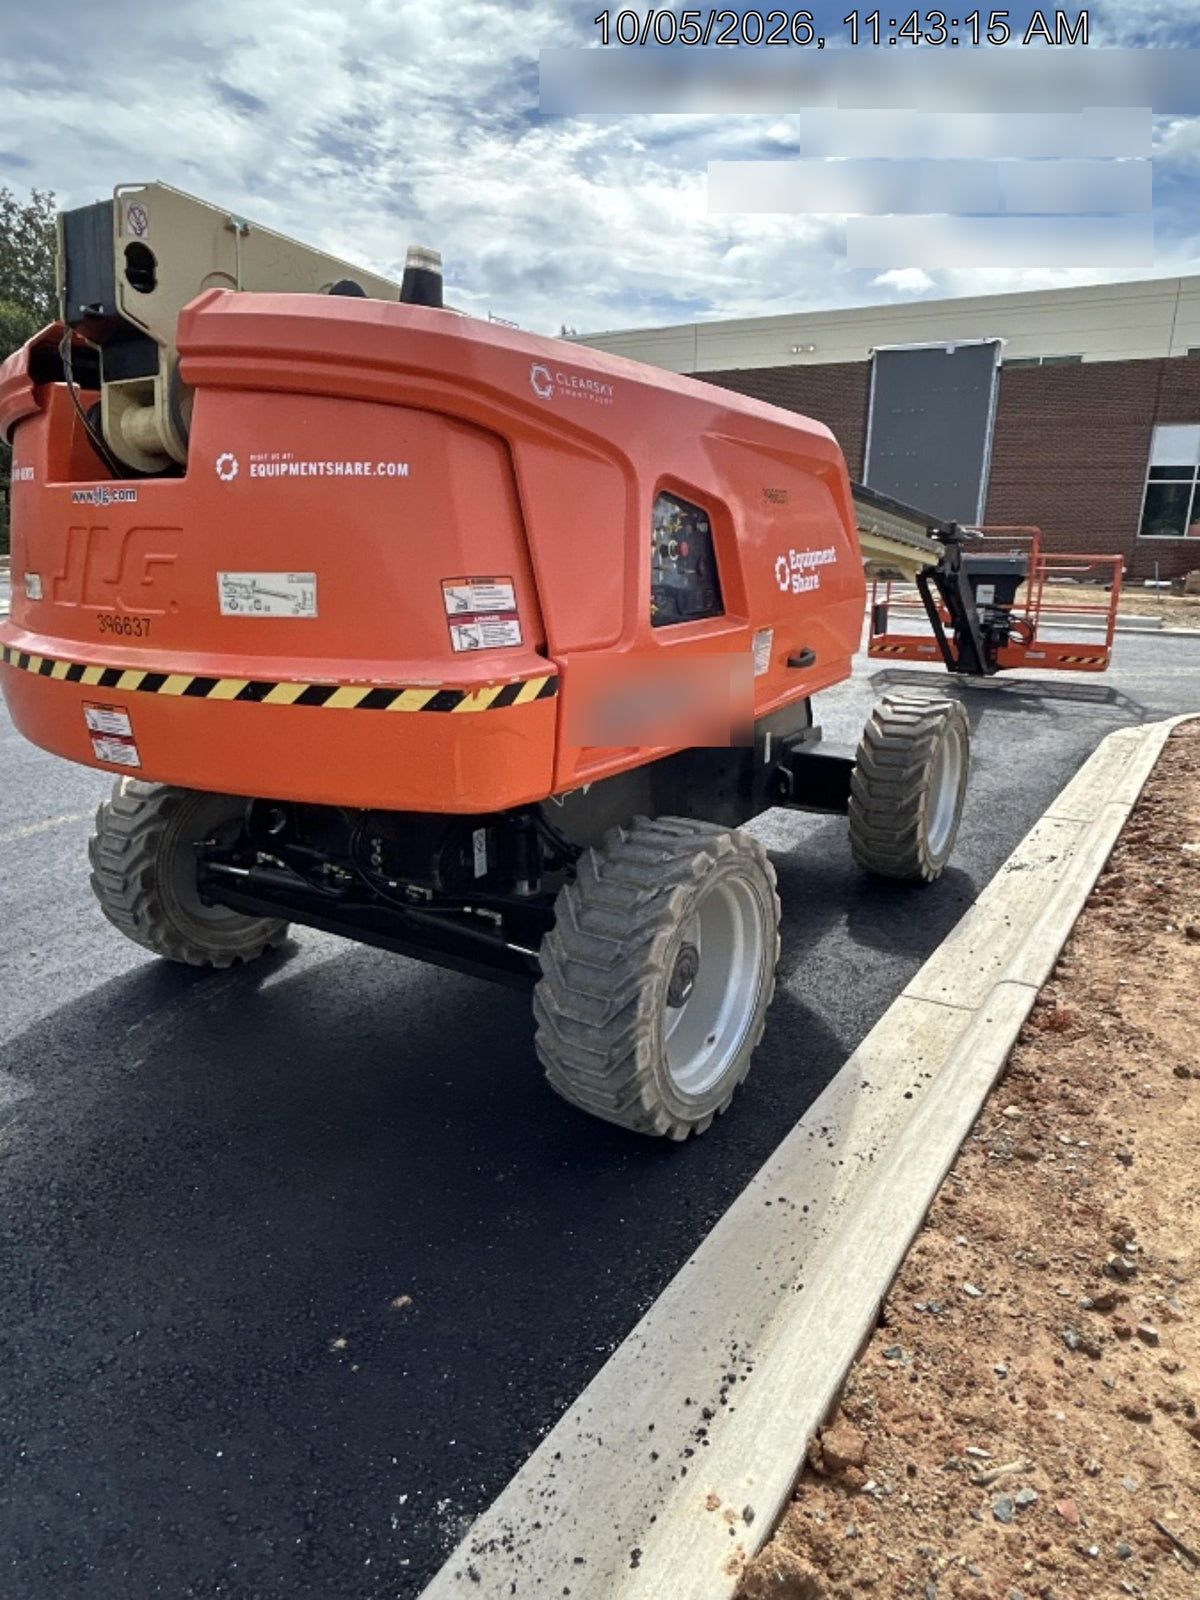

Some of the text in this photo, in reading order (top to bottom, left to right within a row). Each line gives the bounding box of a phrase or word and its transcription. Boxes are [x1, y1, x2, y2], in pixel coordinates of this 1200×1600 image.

[555, 372, 614, 396] CLEARSKY
[250, 462, 409, 478] EQUIPMENTSHARE.COM
[71, 486, 137, 506] www.jlg.com
[789, 545, 837, 573] Equipment
[792, 573, 820, 594] Share
[97, 613, 151, 638] 396637
